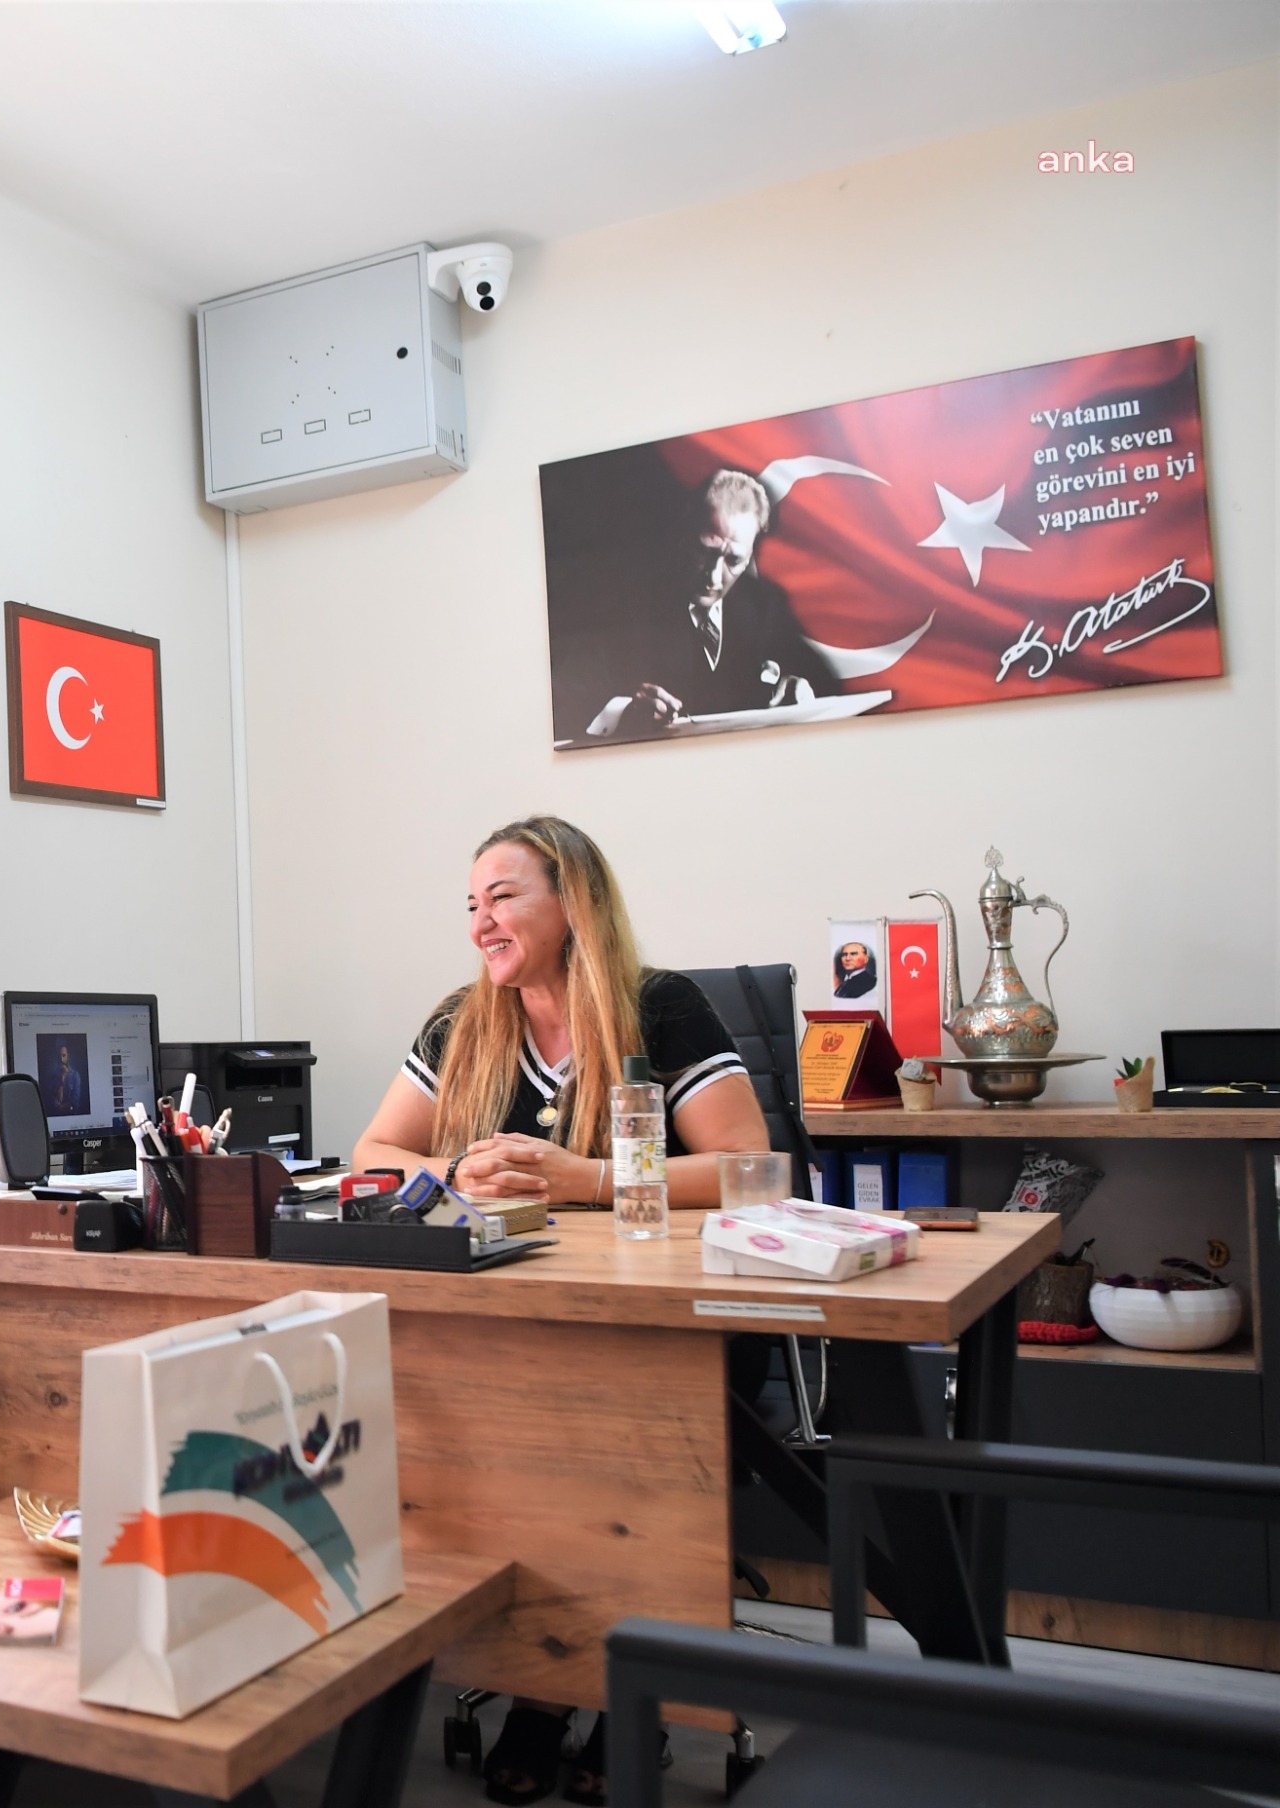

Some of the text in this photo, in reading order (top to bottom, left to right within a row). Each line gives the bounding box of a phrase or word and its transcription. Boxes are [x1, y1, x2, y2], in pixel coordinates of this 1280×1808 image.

[1033, 426, 1173, 466] en çok seven
[1036, 452, 1196, 503] görevini en iyi
[82, 1139, 103, 1150] Casper
[857, 1182, 879, 1190] GELEN
